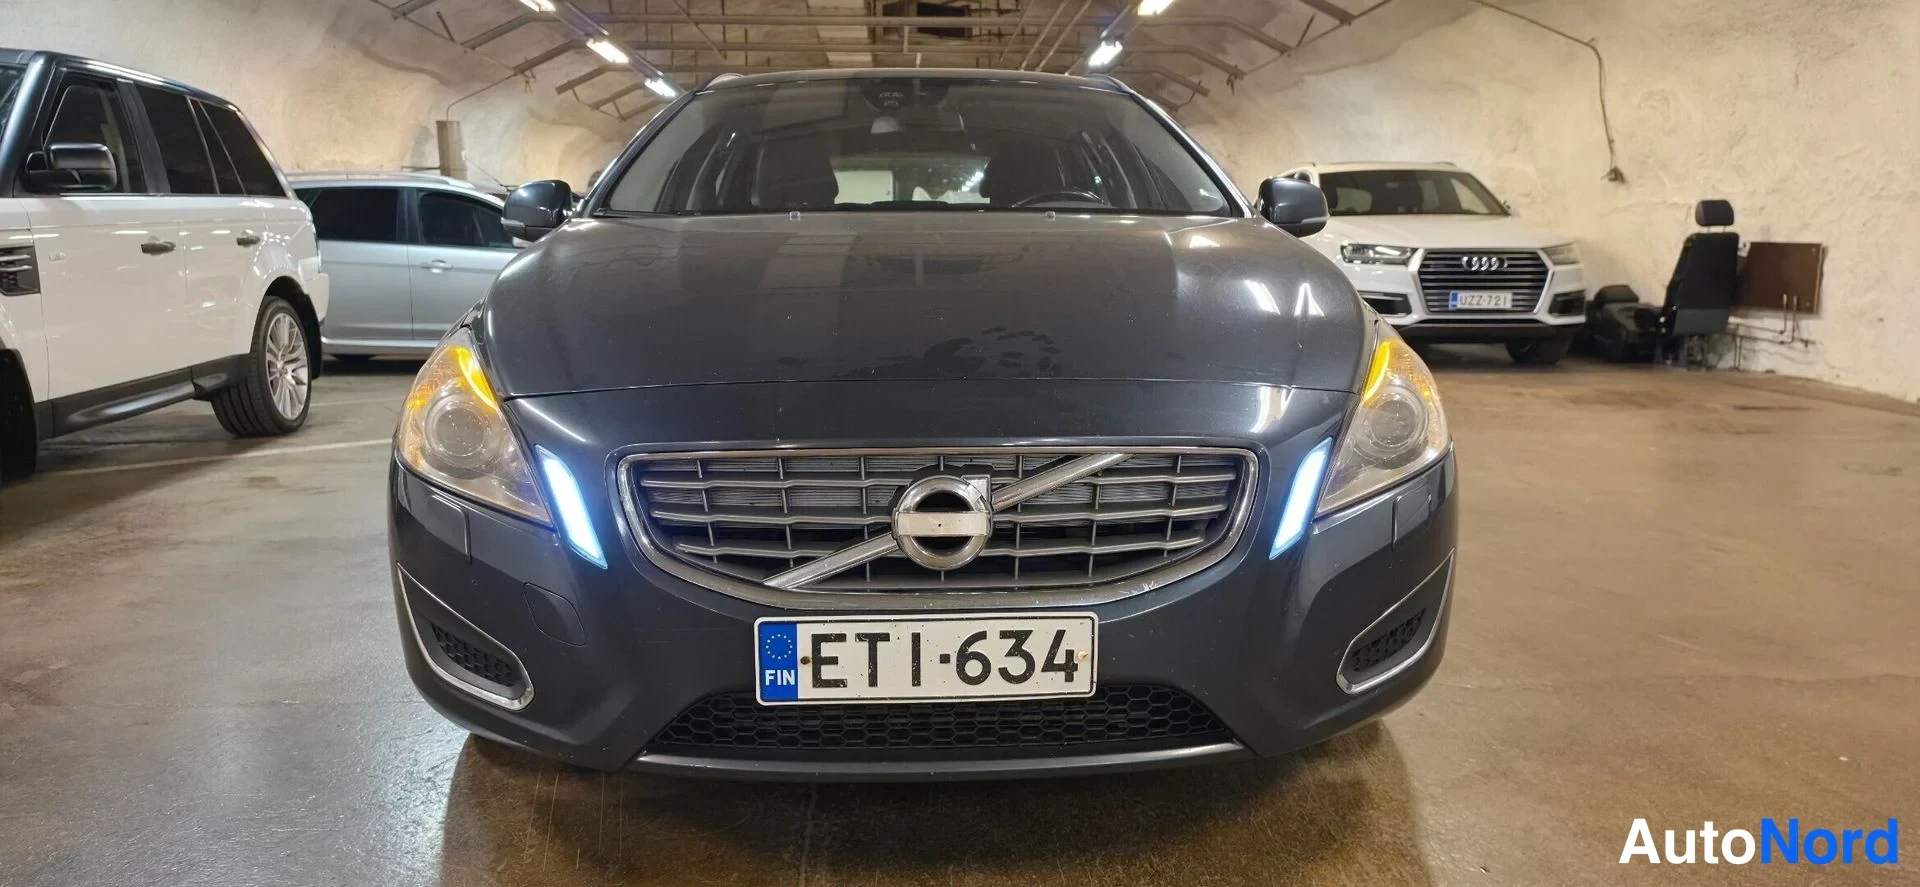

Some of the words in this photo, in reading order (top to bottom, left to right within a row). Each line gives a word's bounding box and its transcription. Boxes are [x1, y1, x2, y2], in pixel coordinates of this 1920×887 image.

[1460, 294, 1508, 307] UZZ-721
[811, 629, 1079, 688] ETI-634
[765, 669, 795, 686] FIN
